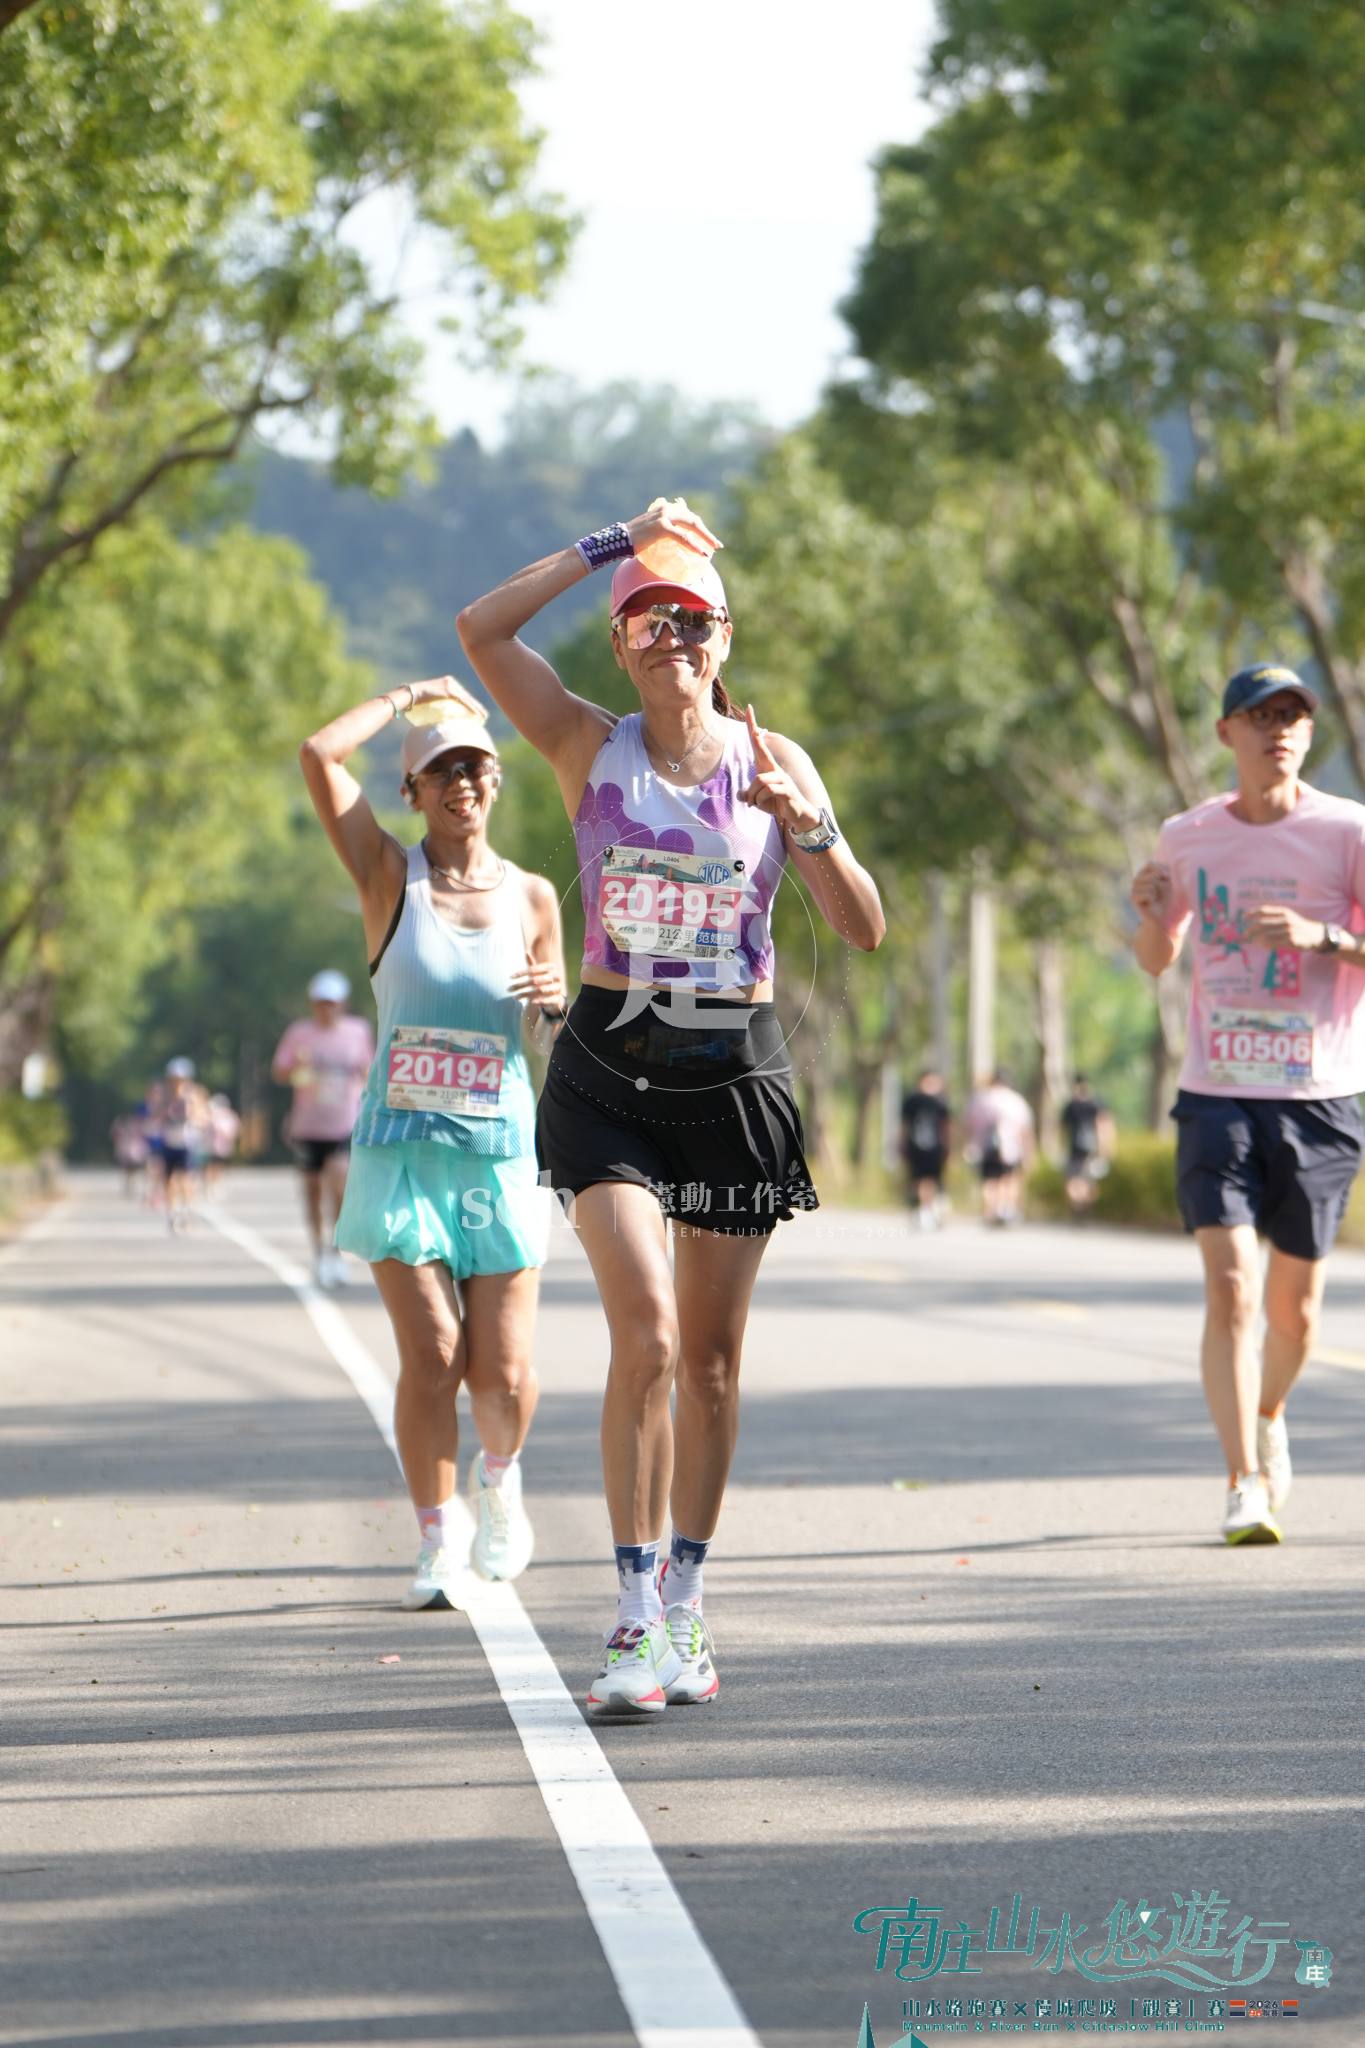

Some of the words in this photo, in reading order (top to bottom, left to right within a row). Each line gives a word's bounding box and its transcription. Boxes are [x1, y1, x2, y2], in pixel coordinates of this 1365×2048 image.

[602, 880, 736, 928] 20195
[1214, 1033, 1311, 1062] 10506
[391, 1053, 499, 1090] 20194
